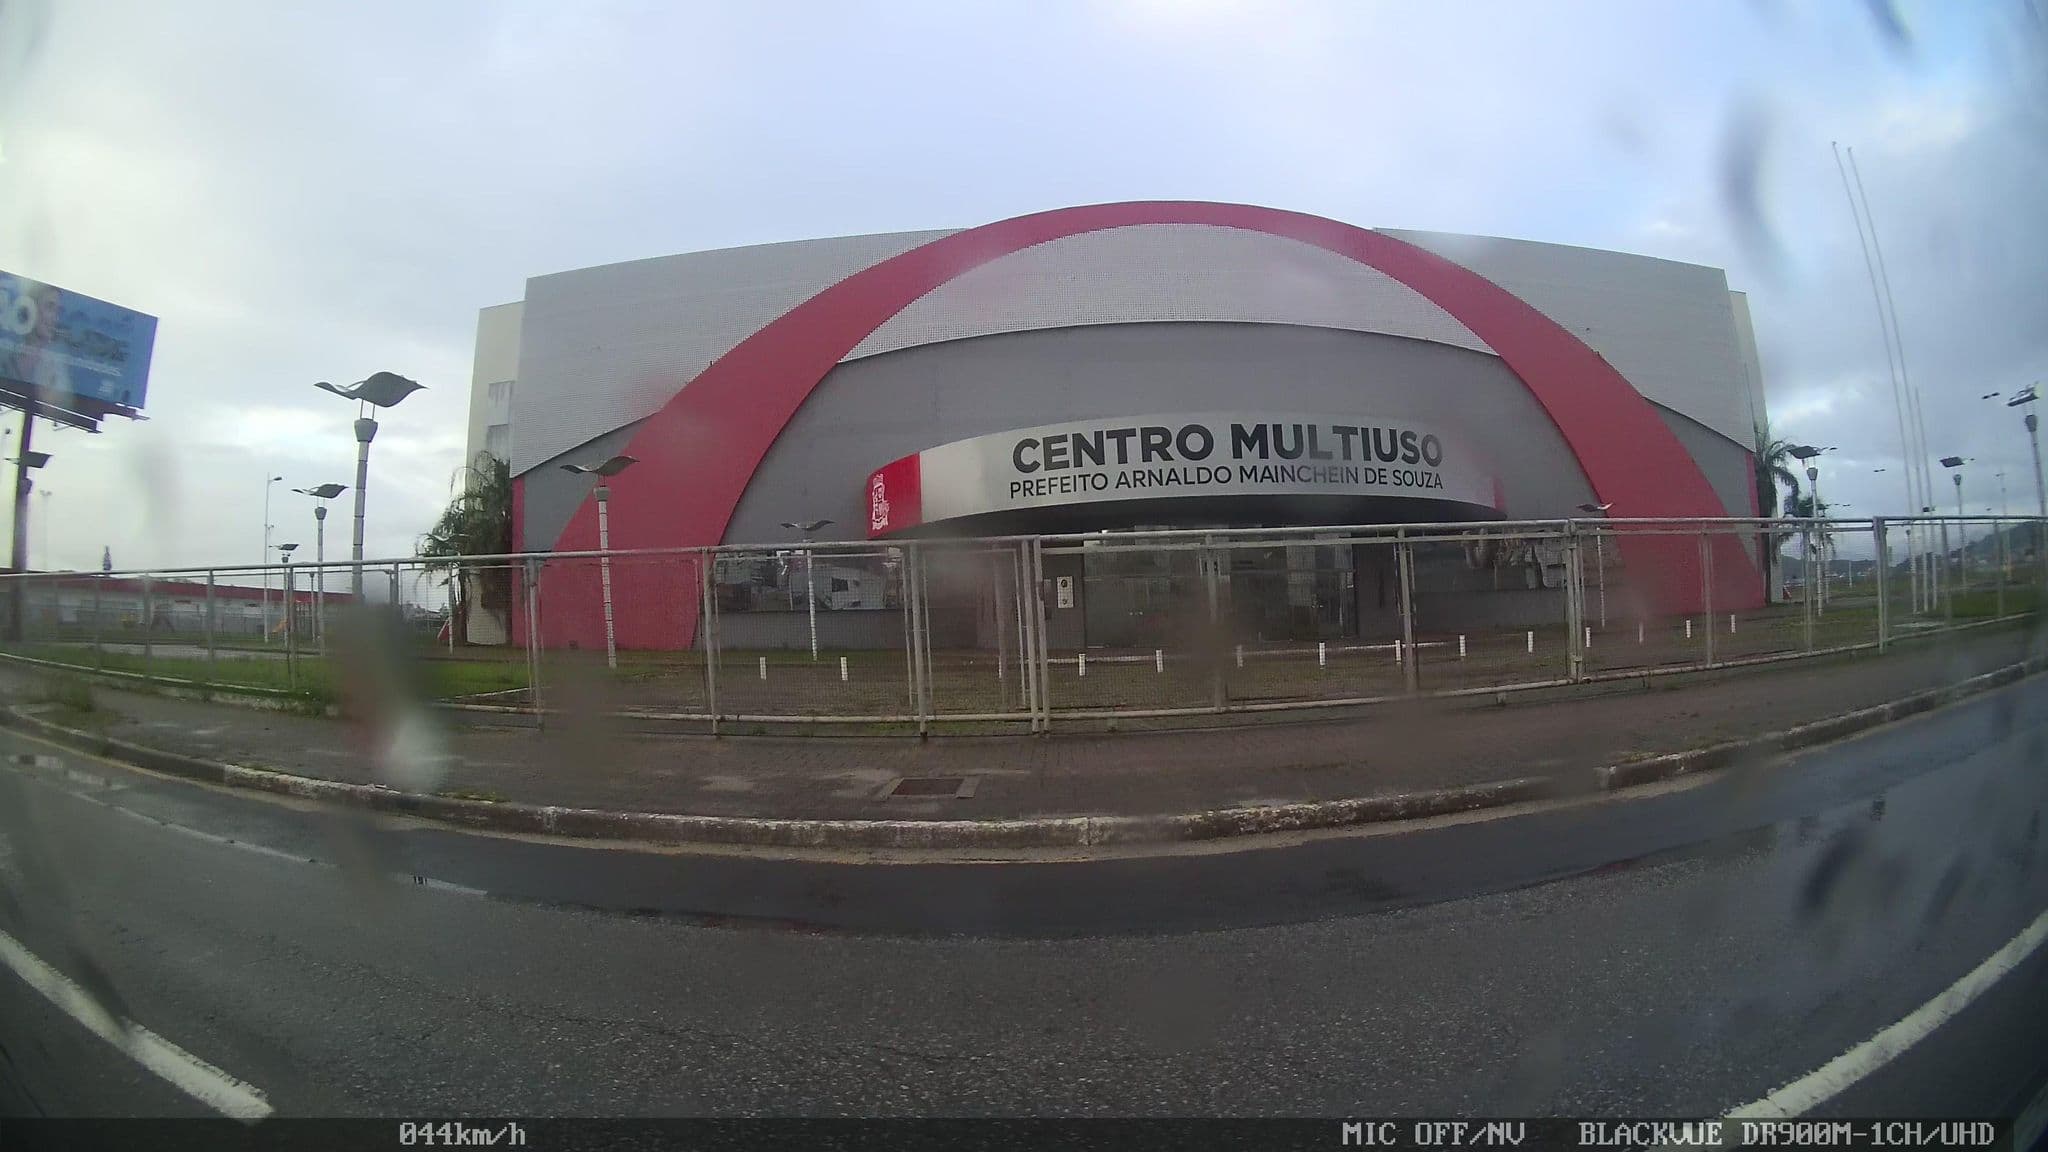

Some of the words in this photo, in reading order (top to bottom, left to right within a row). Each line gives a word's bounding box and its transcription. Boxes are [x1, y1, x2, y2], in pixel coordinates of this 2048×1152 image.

[1012, 423, 1214, 473] CENTRO
[1230, 423, 1443, 467] MULTIUSO
[1009, 472, 1109, 499] PREFEITO
[1115, 465, 1232, 489] ARNALDO
[1239, 465, 1359, 484] MAINCHEIN
[1364, 468, 1388, 485] DE
[1392, 469, 1444, 489] SOUZA
